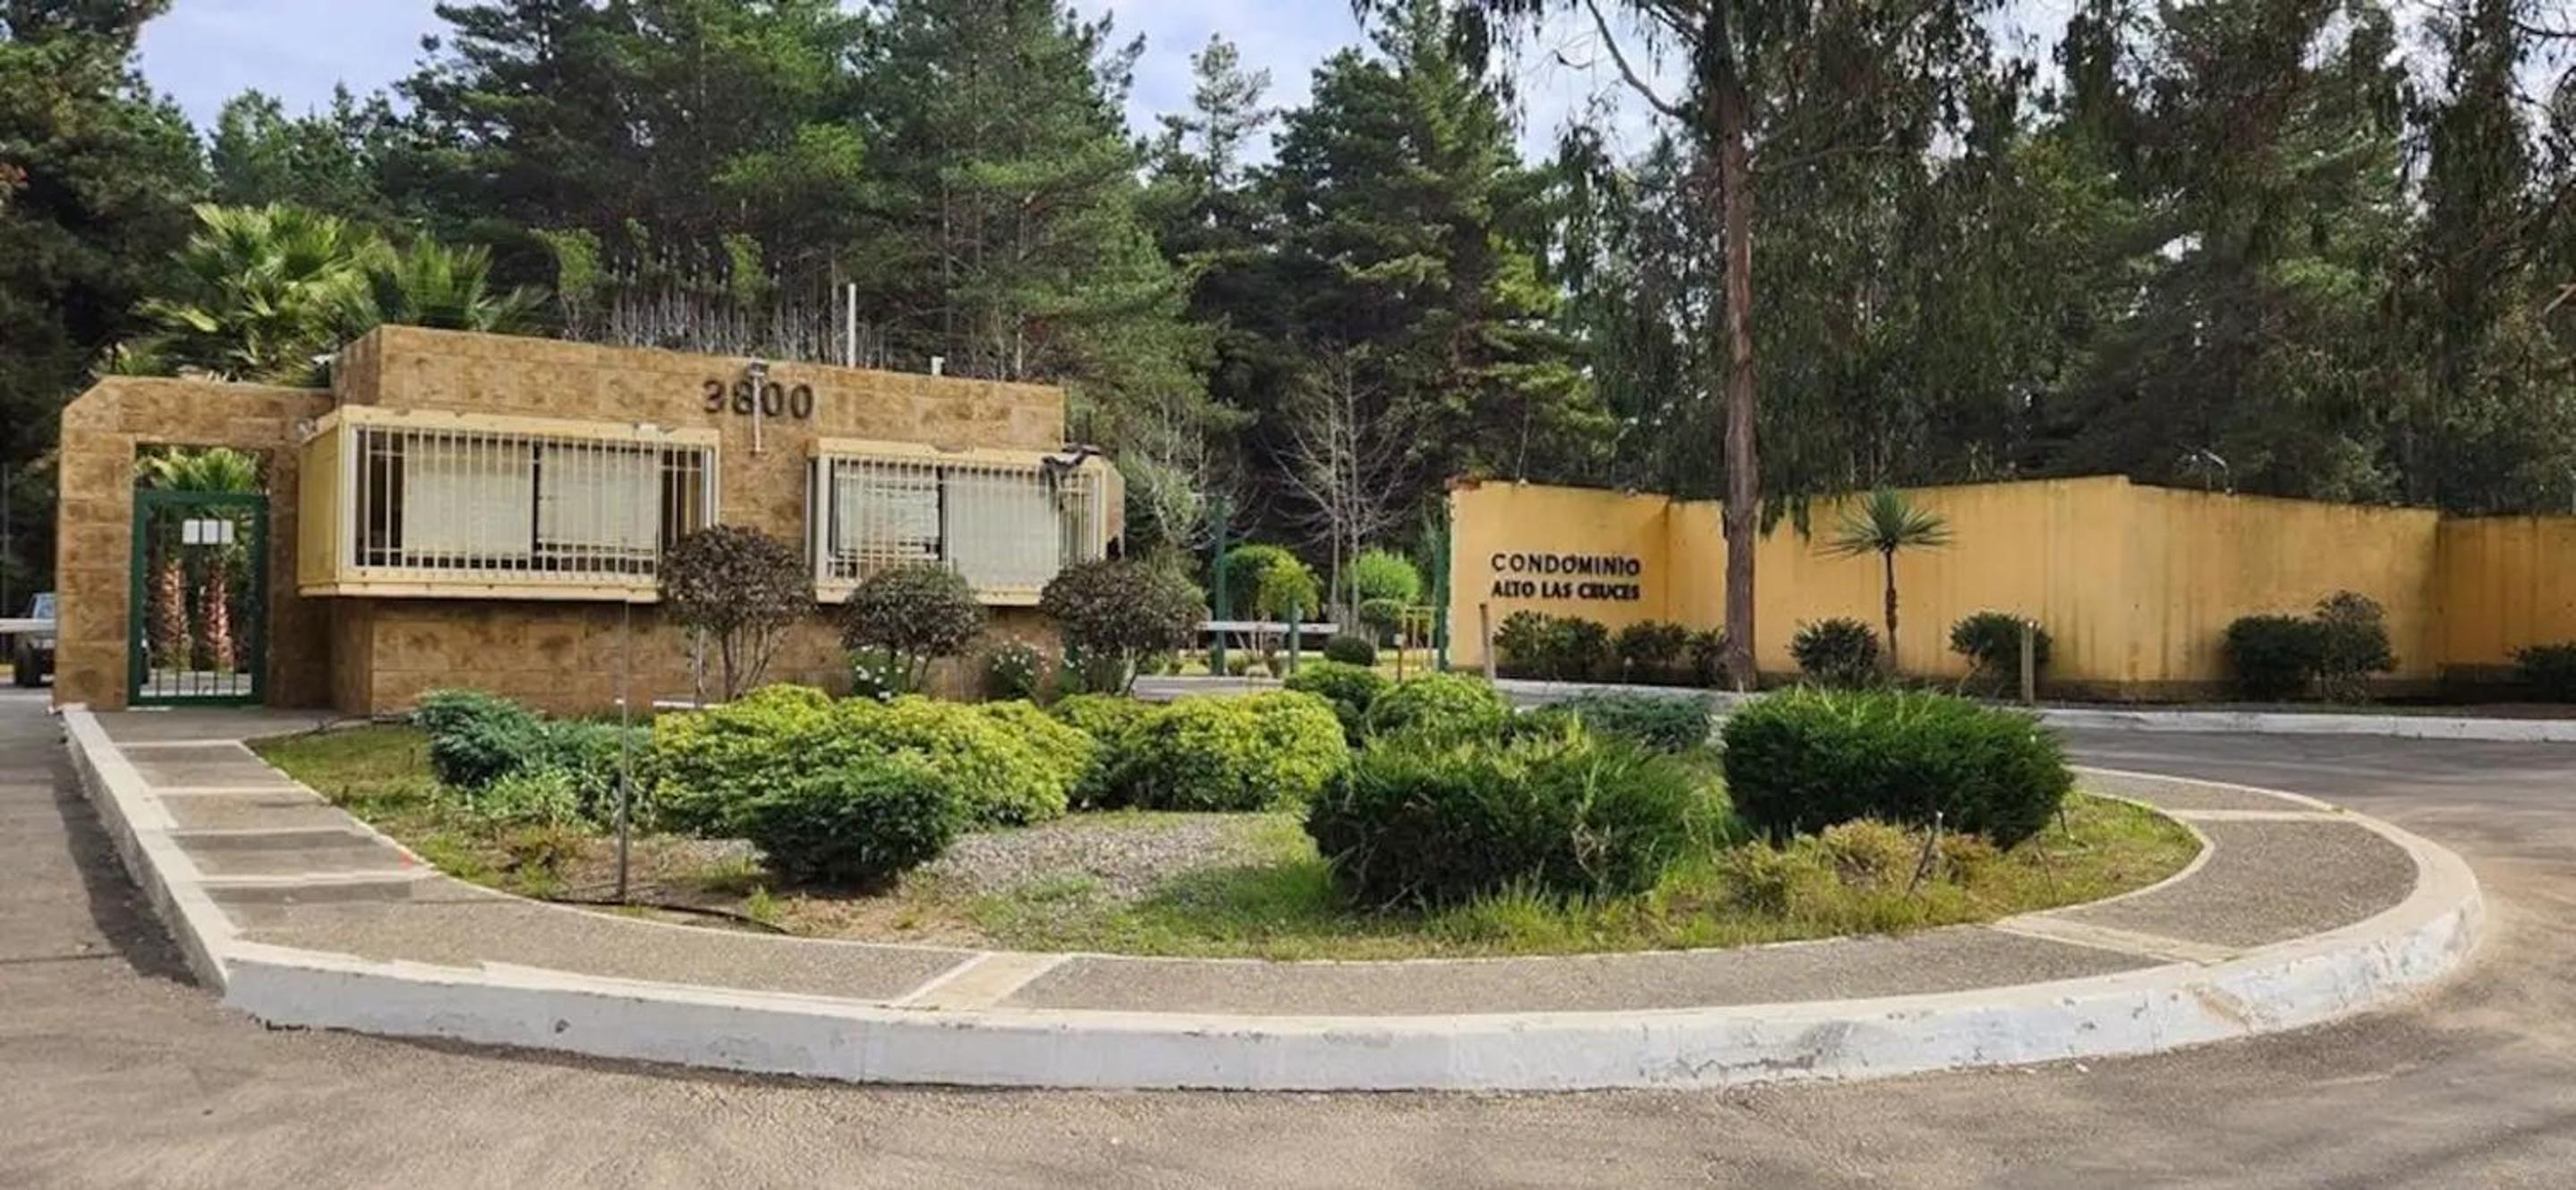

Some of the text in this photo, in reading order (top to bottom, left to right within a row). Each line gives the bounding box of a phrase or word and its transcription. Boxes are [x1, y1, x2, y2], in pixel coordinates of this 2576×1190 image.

[703, 379, 813, 419] 3800
[1492, 554, 1641, 576] CONDOMINIO
[1492, 581, 1535, 598] ALTO
[1542, 582, 1571, 599] LAS
